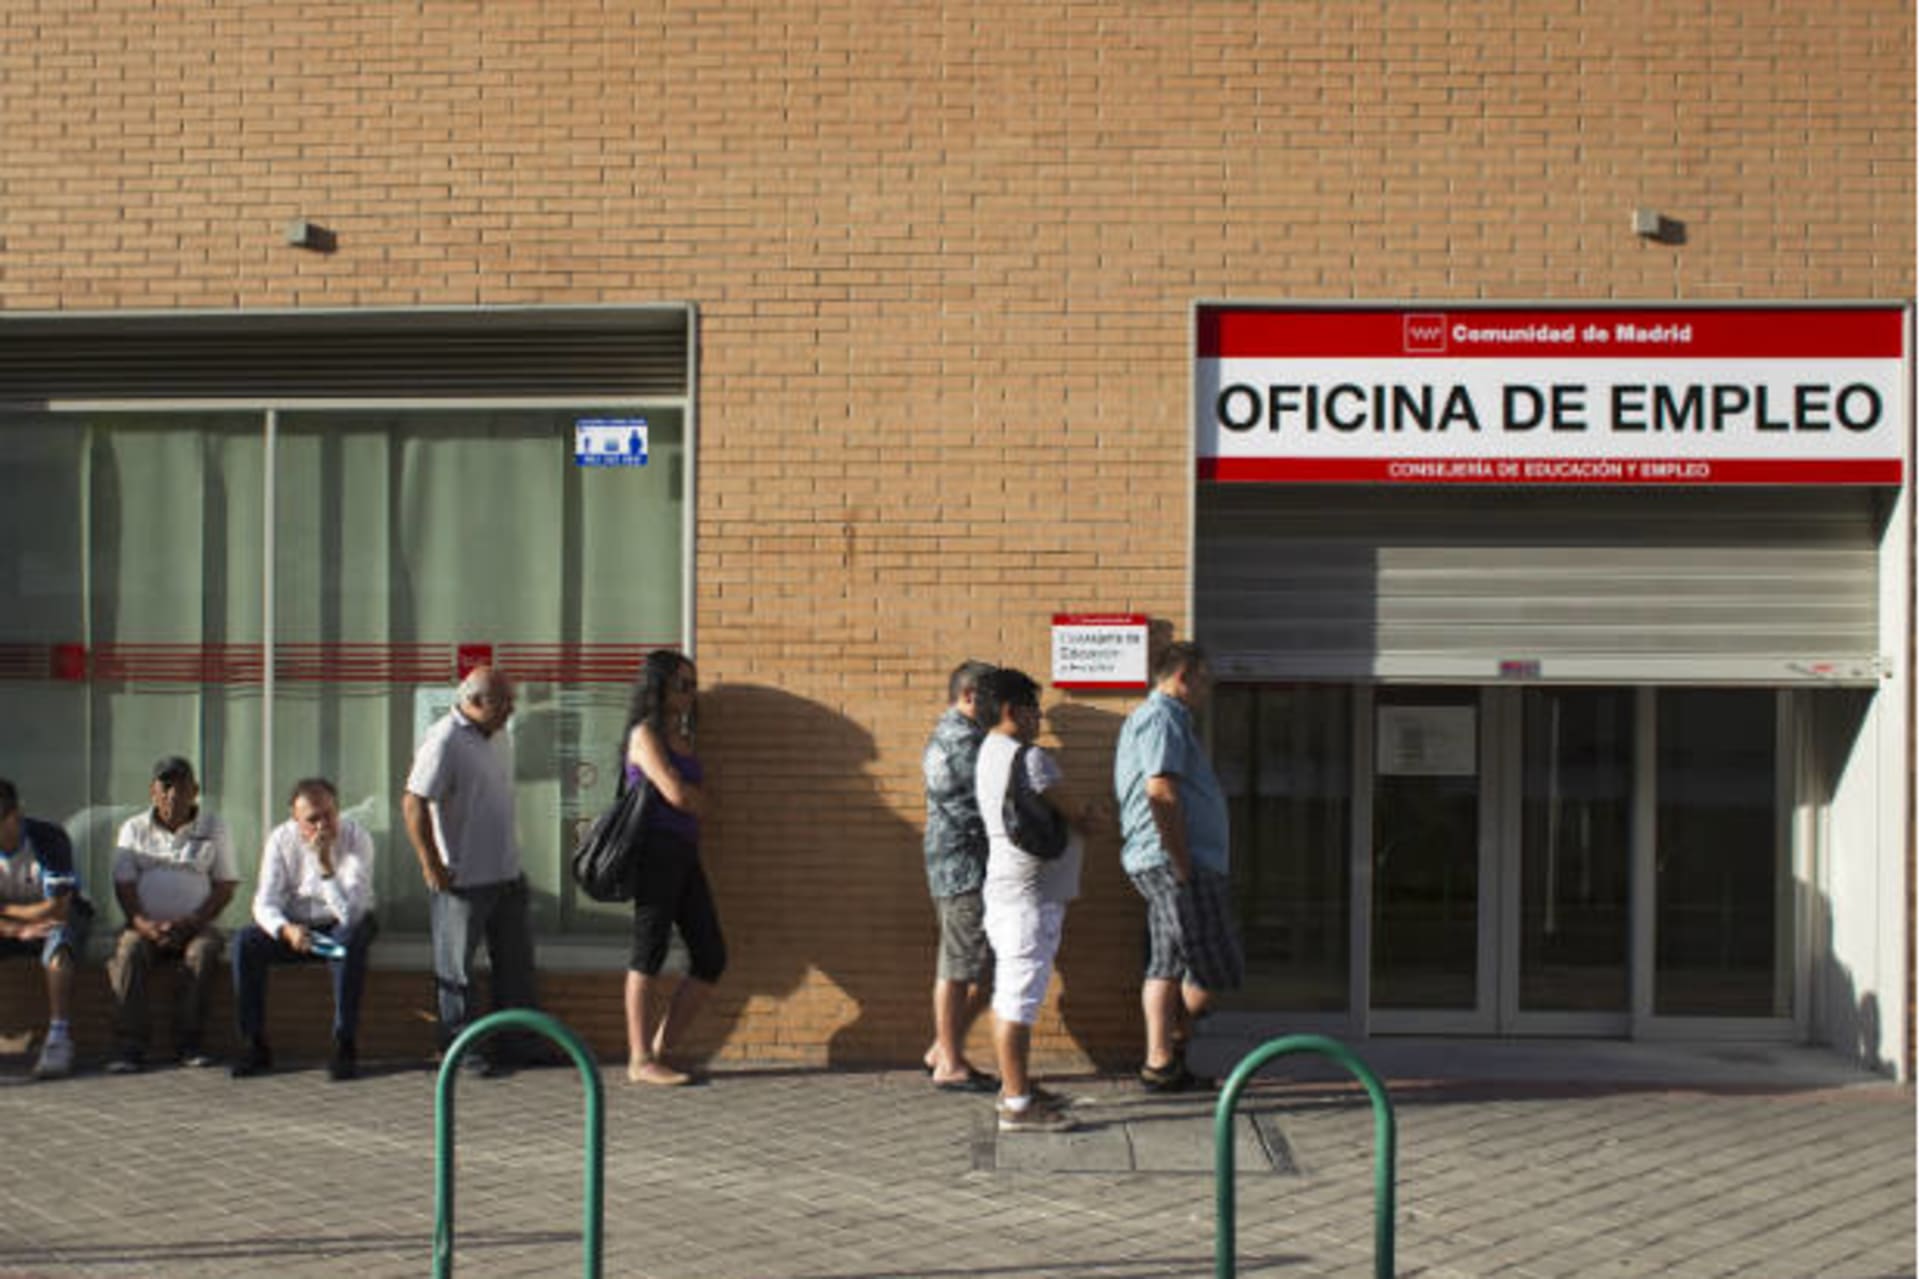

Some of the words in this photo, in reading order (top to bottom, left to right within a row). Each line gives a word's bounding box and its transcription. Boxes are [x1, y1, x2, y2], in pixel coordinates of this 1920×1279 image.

[1452, 324, 1576, 343] Comunidad
[1581, 324, 1610, 343] de
[1614, 324, 1693, 343] Madrid
[1216, 383, 1481, 432] OFICINA
[1502, 384, 1587, 431] DE
[1611, 383, 1882, 432] EMPLEO
[1388, 460, 1493, 477] CONSEJERÍA
[1497, 463, 1519, 477] DE
[1524, 459, 1622, 477] EDUCACIÓN
[1626, 463, 1637, 477] Y
[1641, 463, 1710, 477] EMPLEO
